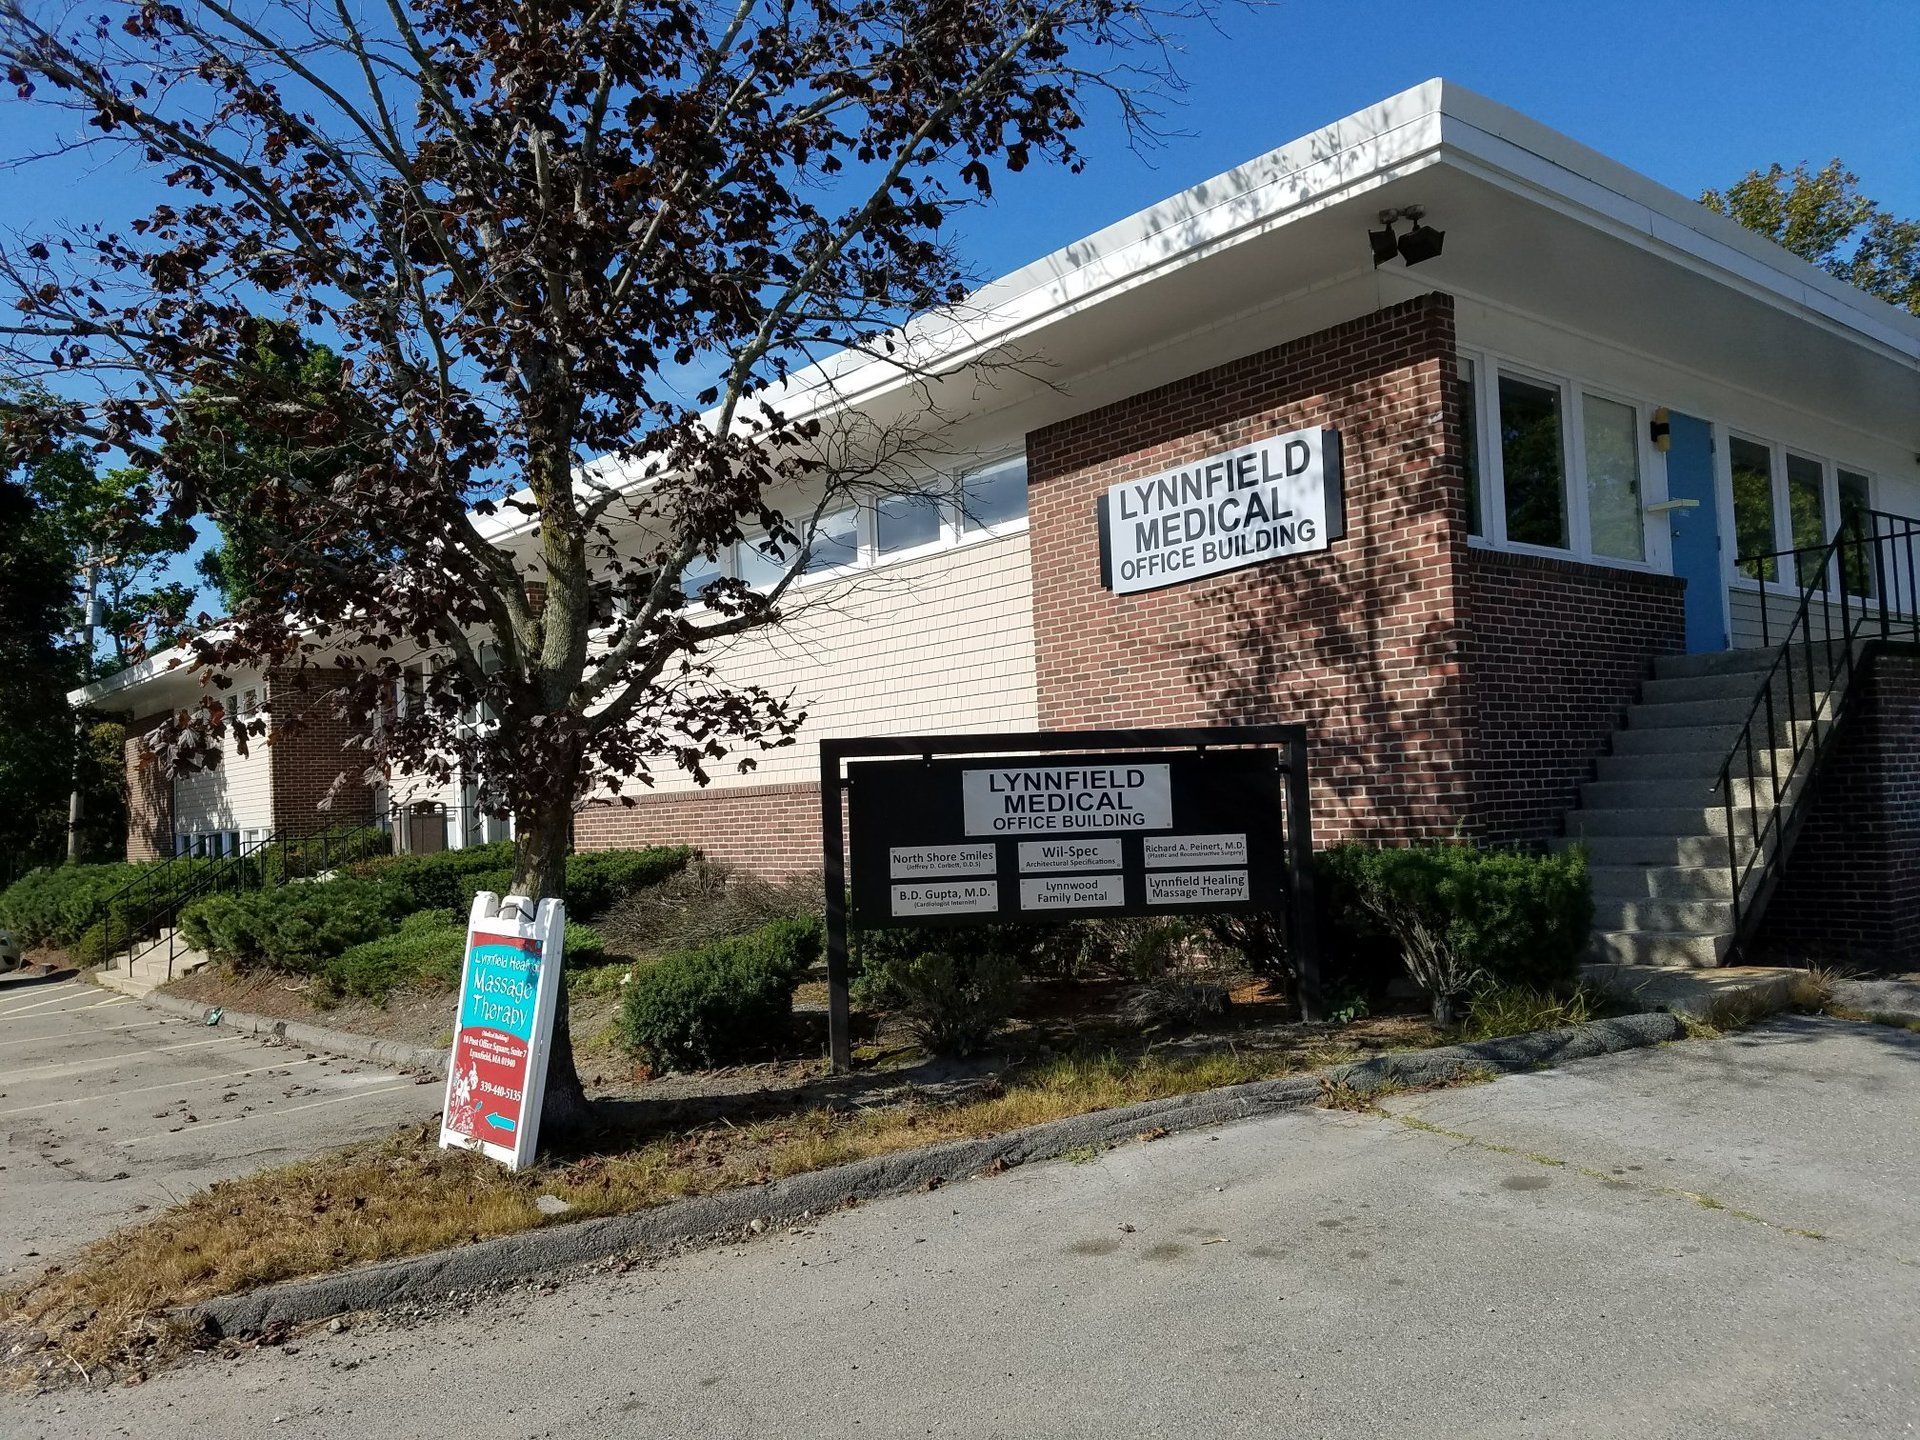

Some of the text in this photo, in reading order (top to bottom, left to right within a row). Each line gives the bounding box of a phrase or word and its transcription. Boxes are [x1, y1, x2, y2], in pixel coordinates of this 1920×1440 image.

[1120, 439, 1311, 520] LYNNFIELD
[1135, 487, 1293, 554] MEDICAL
[1121, 519, 1316, 581] OFFICE BUILDING
[989, 769, 1145, 792] LYNNFIELD
[1004, 792, 1133, 813] MEDICAL
[993, 813, 1145, 830] OFFICE BUILDING
[1042, 846, 1099, 859] Wil-Spec
[1146, 844, 1176, 852] Richard
[1190, 842, 1222, 850] Peinert,
[1225, 841, 1245, 849] M.D.
[893, 851, 993, 863] North Shore Smiles
[1070, 858, 1115, 867] Specifications
[1046, 880, 1097, 892] Lynnwood
[1149, 875, 1245, 889] Lynnfield Healing
[900, 888, 990, 900] B.D. Gupta, M.D.
[1038, 891, 1107, 904] Family Dental
[1153, 886, 1242, 898] Massage Therapy
[473, 967, 532, 1004] Massage
[473, 994, 528, 1031] Therapy
[469, 1036, 478, 1046] Post
[479, 1039, 492, 1049] Office
[493, 1042, 510, 1055] Square,
[511, 1047, 523, 1057] Suite
[470, 1048, 492, 1063] Lynnfield,
[492, 1054, 500, 1064] MA
[480, 1081, 521, 1101] 339-440-5135
